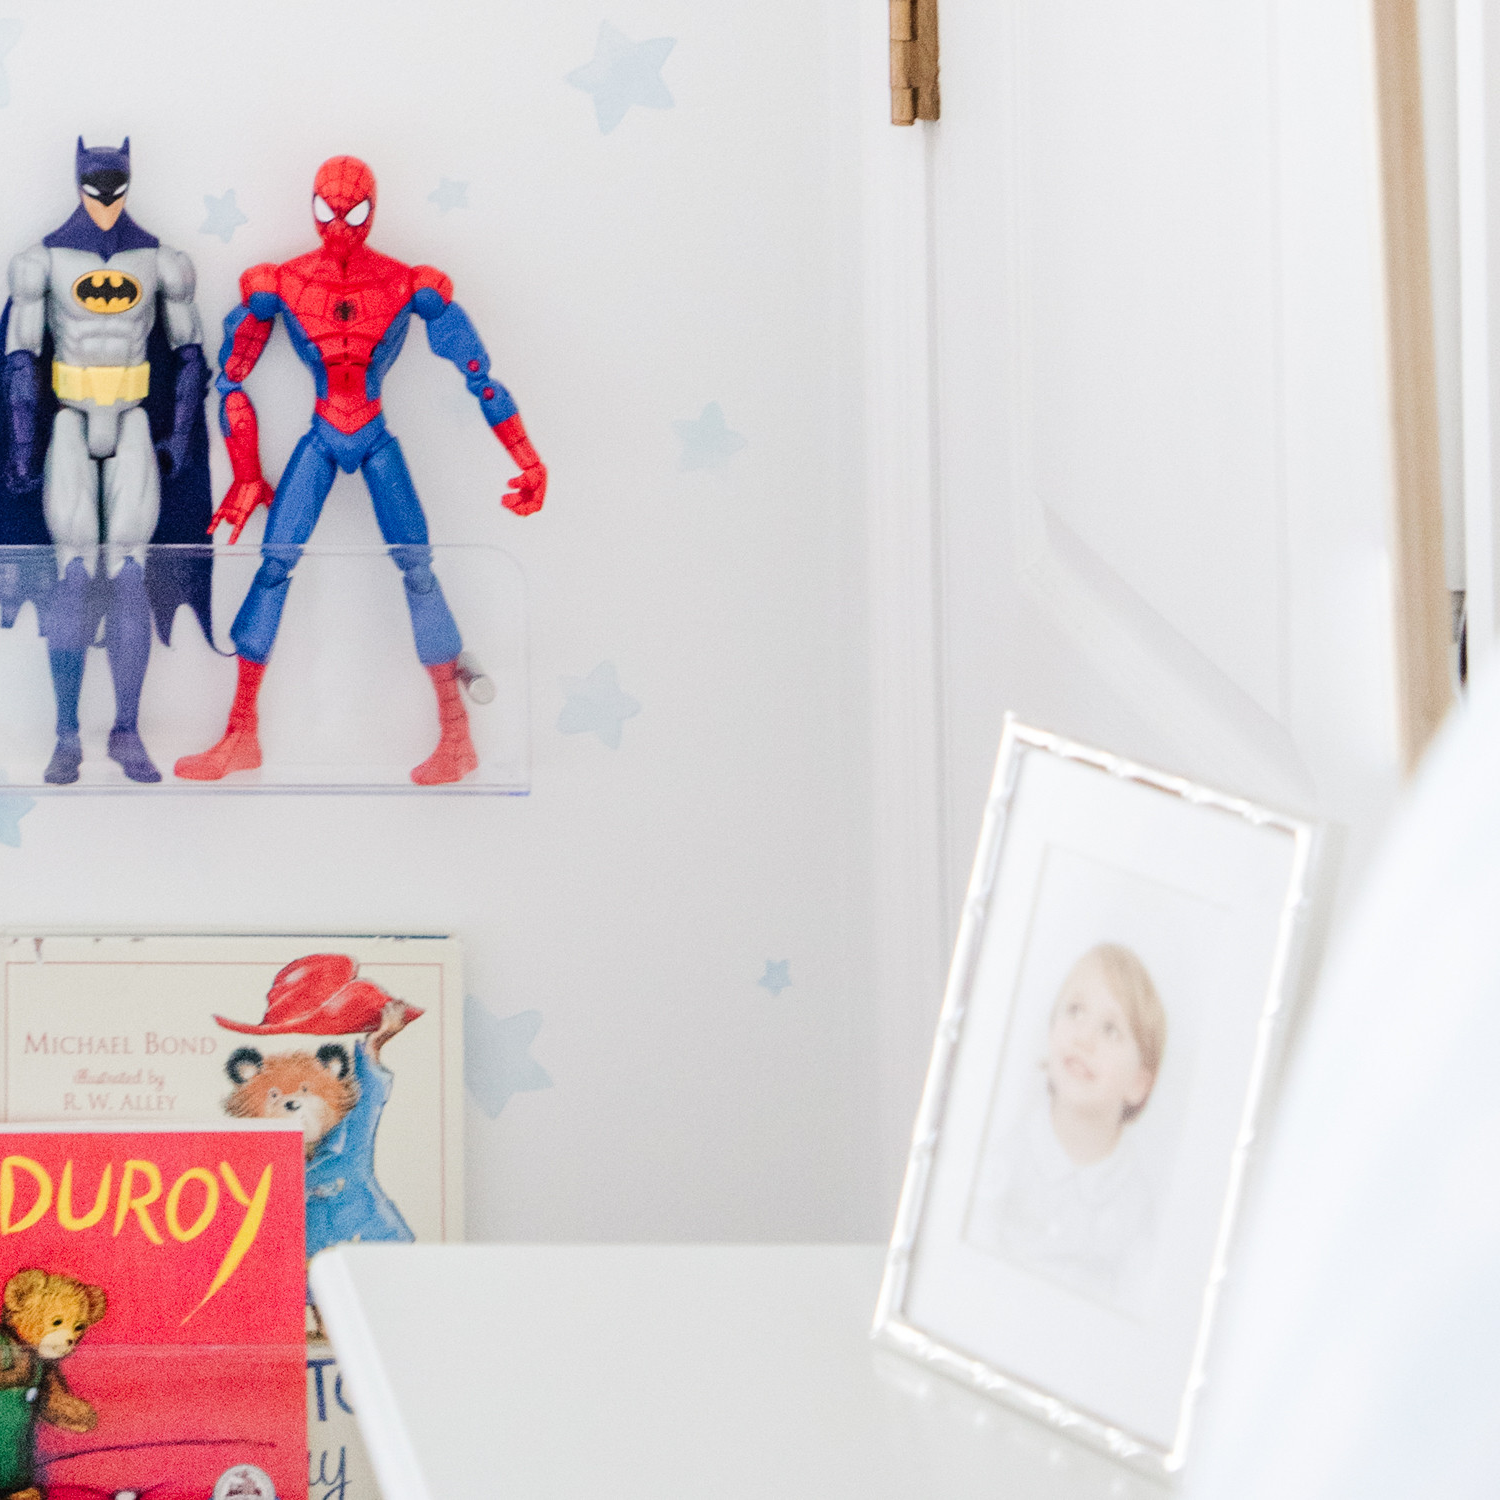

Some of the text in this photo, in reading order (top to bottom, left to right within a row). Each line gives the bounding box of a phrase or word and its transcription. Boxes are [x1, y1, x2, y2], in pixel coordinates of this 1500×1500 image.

[23, 1032, 217, 1056] MICHAEL BOND
[149, 1069, 166, 1090] by
[120, 1094, 178, 1111] ALLEY
